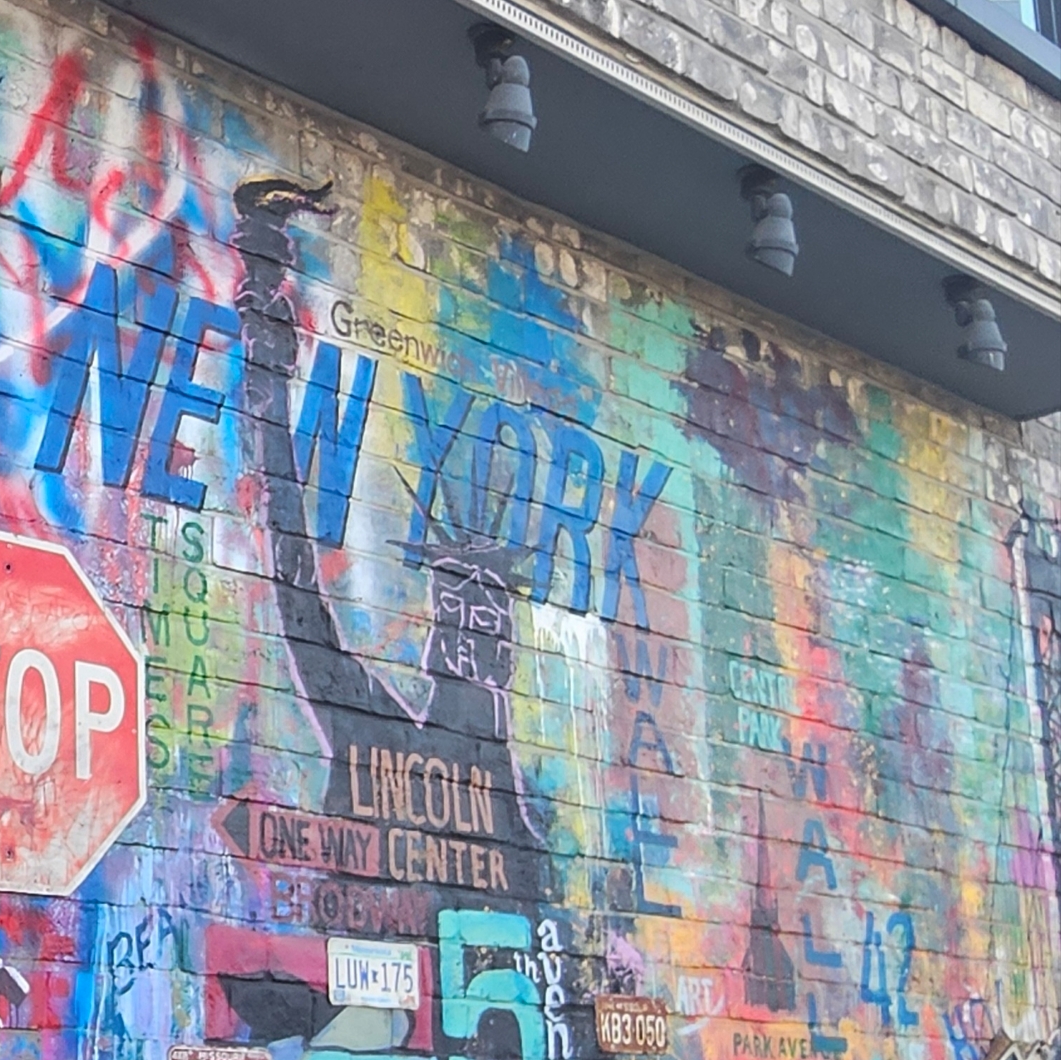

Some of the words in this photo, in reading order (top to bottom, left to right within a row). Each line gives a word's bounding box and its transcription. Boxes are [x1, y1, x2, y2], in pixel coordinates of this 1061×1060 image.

[33, 262, 380, 547] NEW
[395, 370, 674, 636] YORK
[140, 511, 172, 770] TIMES
[180, 520, 215, 800] SQUARE
[348, 743, 495, 836] LINCOLN
[258, 811, 311, 862] ONE
[318, 823, 373, 871] WAY
[388, 827, 509, 892] CENTER
[513, 950, 541, 984] th
[733, 1032, 777, 1060] PARK
